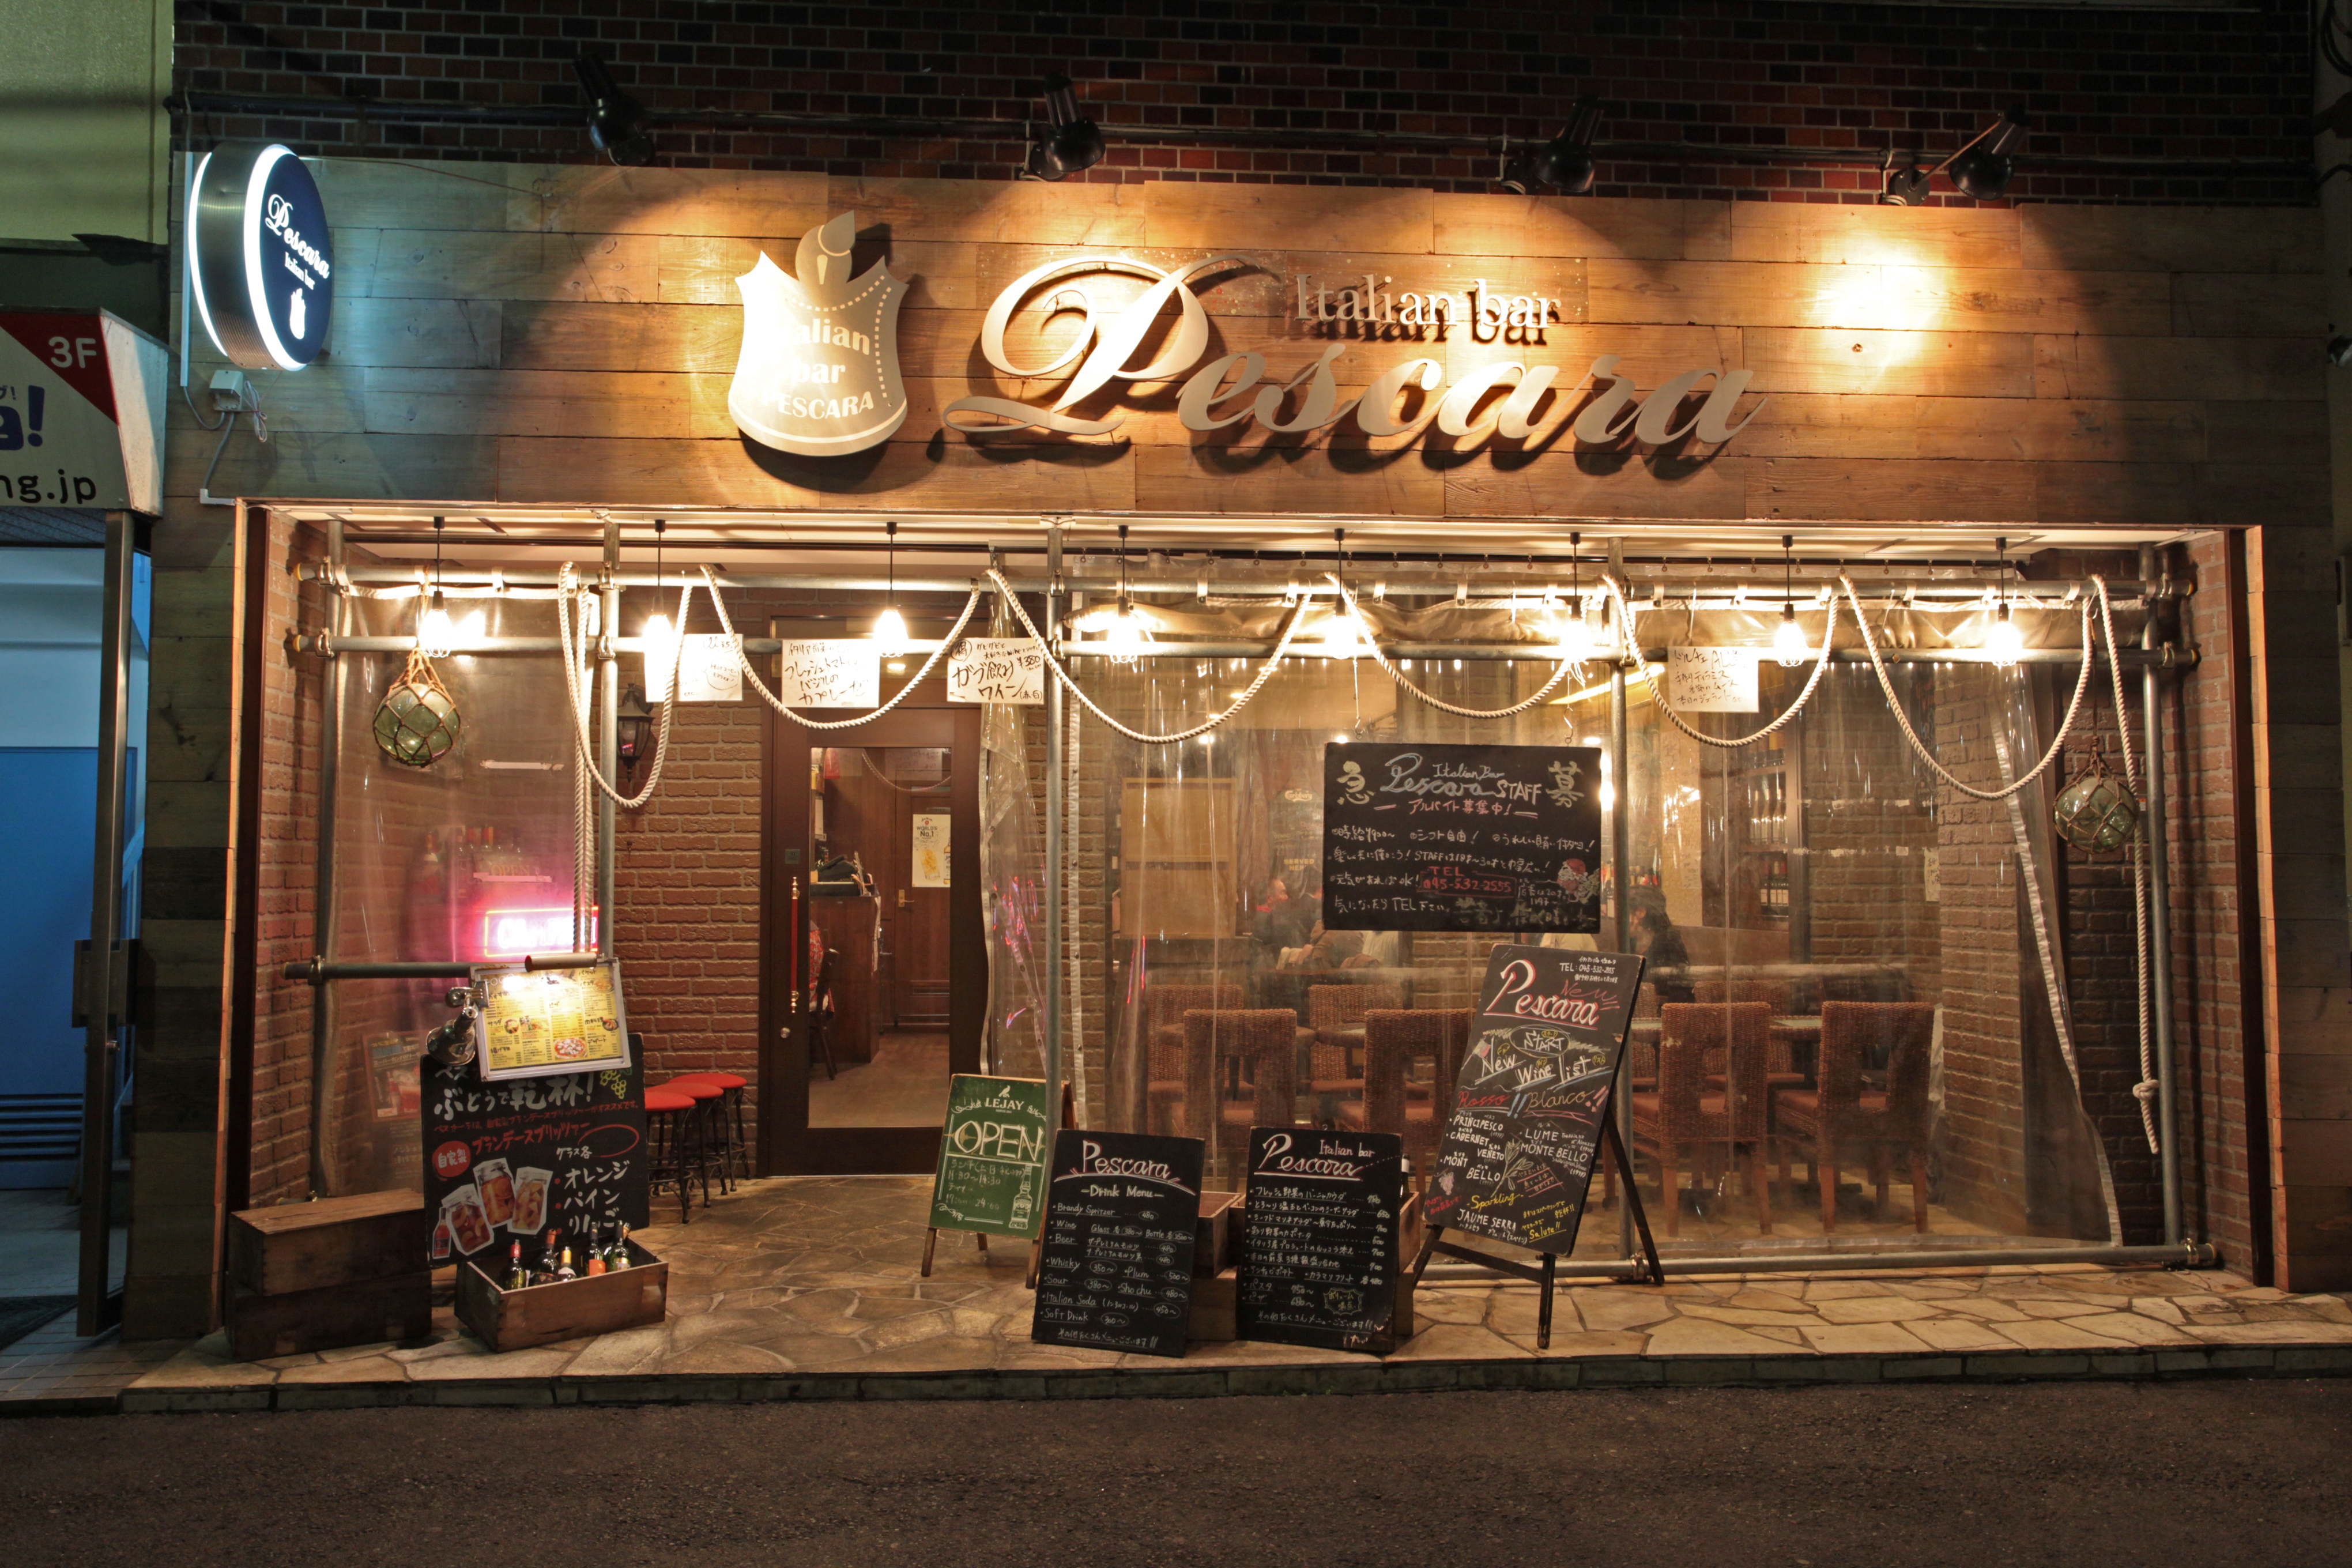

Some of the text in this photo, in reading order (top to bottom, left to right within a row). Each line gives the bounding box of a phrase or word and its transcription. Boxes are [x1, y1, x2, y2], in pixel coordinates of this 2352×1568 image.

[265, 194, 329, 278] Pescara
[285, 251, 315, 290] Italian bar
[1295, 273, 1562, 329] Italian bar
[49, 336, 97, 368] 3F
[942, 254, 1768, 445] Pescara
[792, 357, 846, 383] bar
[1016, 655, 1041, 669] ¥380
[800, 674, 839, 692] バジルの
[952, 660, 1014, 688] ガブ飲み
[1433, 763, 1480, 779] Italian
[1337, 760, 1376, 805] 急
[1492, 779, 1543, 805] STAFF
[1428, 866, 1465, 876] TEL
[1484, 959, 1600, 1026] Pescara
[1481, 1035, 1517, 1077] New
[1515, 1064, 1553, 1084] Wine
[985, 1098, 1024, 1110] LEJAY
[1453, 1115, 1503, 1132] PRINCIPESCO
[954, 1120, 1046, 1162] OPEN
[1450, 1132, 1490, 1147] CABERNET
[1525, 1128, 1559, 1141] LUME
[438, 1148, 468, 1169] 自家製
[1259, 1133, 1365, 1177] Pescara
[1319, 1140, 1375, 1158] Italian bar
[1477, 1148, 1505, 1160] VENETO
[1520, 1143, 1588, 1162] MONTE BELLO
[1083, 1139, 1170, 1179] Pescara
[1443, 1155, 1468, 1167] MONT
[564, 1159, 630, 1189] オレンジ
[1466, 1167, 1501, 1181] BELLO
[564, 1188, 620, 1209] パイン
[1090, 1184, 1153, 1197] Drink Menu
[1057, 1203, 1155, 1220] Brandy Spritzer 480
[1457, 1208, 1516, 1231] JAUME SERRA
[1055, 1234, 1075, 1243] Beer
[1057, 1220, 1077, 1228] Wine
[1091, 1224, 1110, 1234] Glass
[1146, 1230, 1164, 1238] Bottle
[1050, 1257, 1081, 1272] Whisky
[1127, 1266, 1149, 1279] Plum
[1047, 1274, 1068, 1284] Sour
[1249, 1278, 1272, 1291] パスタ
[1046, 1291, 1073, 1304] Italian
[1078, 1295, 1096, 1306] Soda
[1045, 1309, 1089, 1321] Soft Drink
